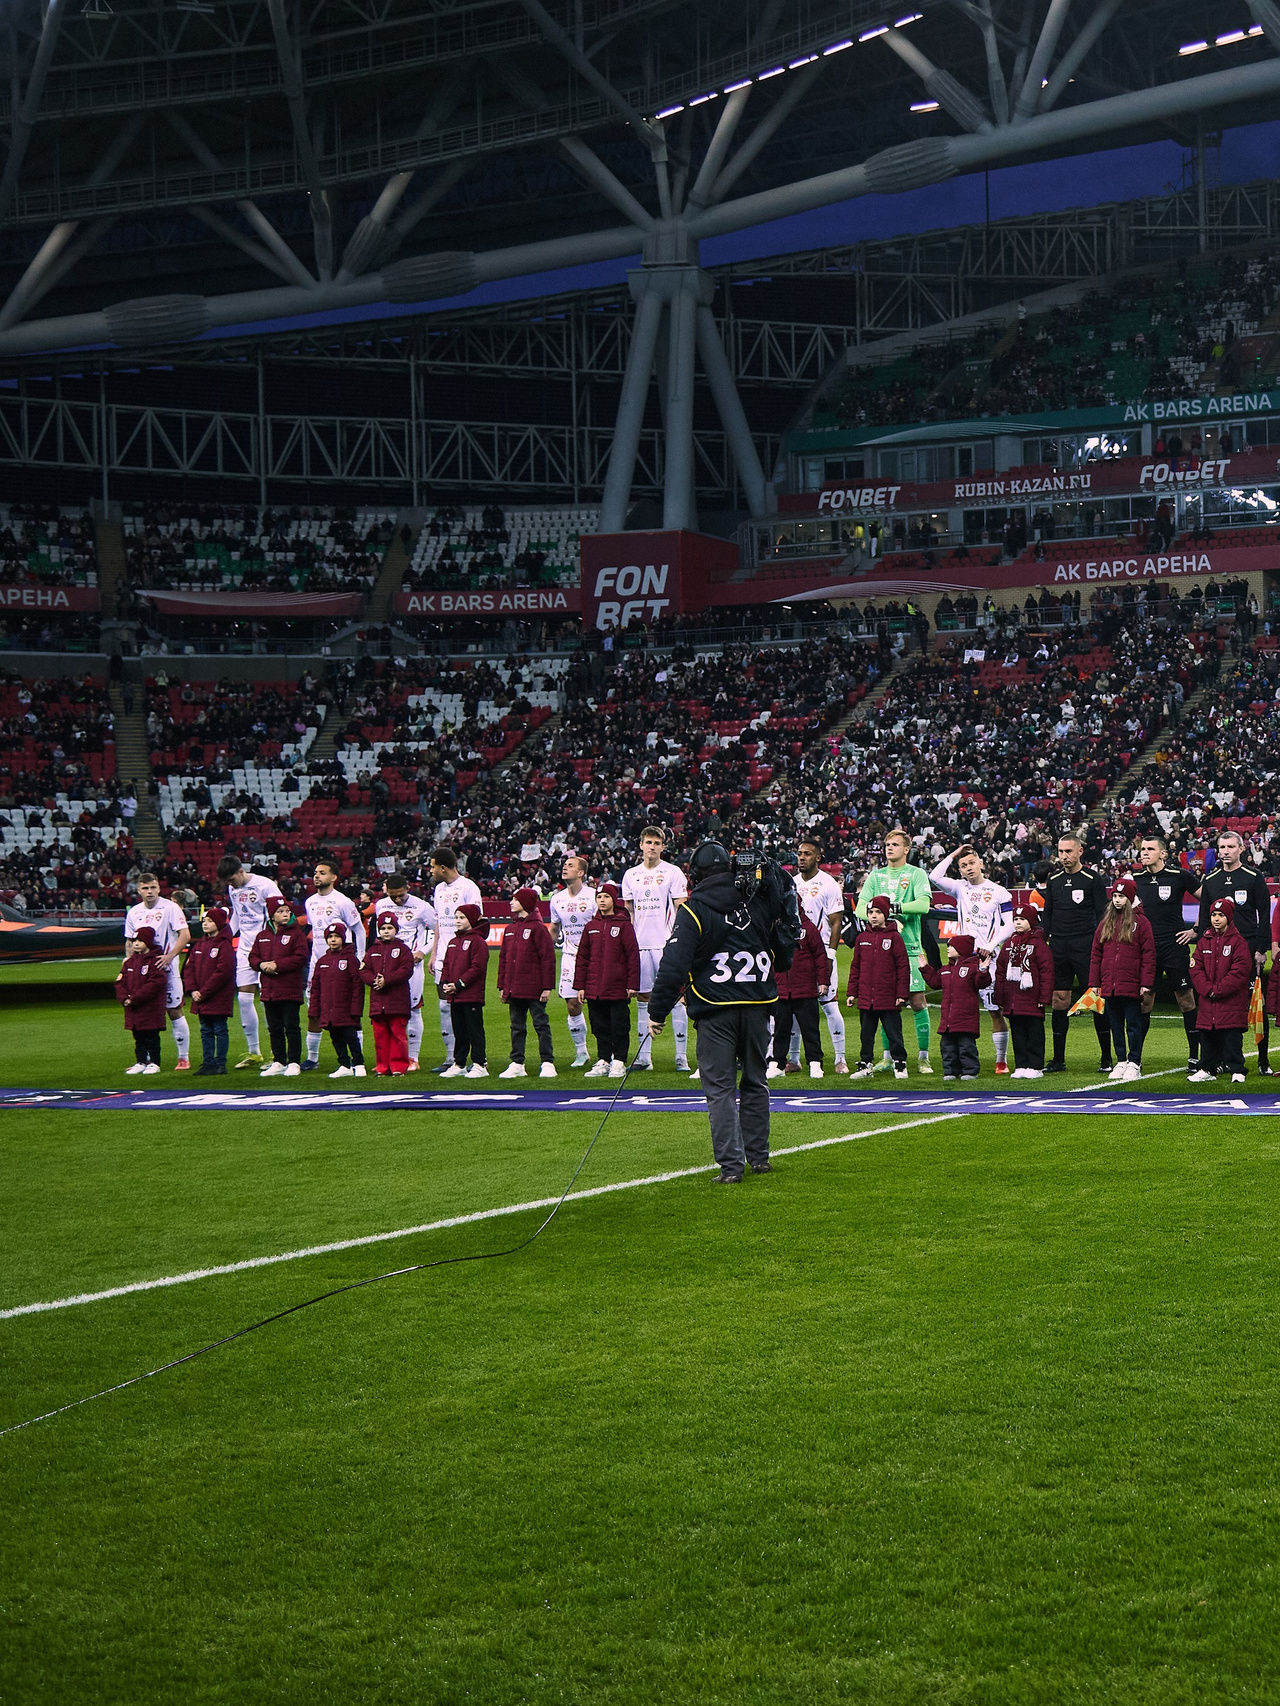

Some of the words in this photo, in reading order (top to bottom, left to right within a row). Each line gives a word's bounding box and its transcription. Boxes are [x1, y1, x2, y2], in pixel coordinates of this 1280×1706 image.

[1124, 404, 1149, 422] AK
[1153, 399, 1202, 419] BARS
[1207, 393, 1272, 415] ARENA
[817, 486, 901, 509] FONBET
[954, 474, 1093, 499] RUBIN-KAZAN.RU
[594, 564, 669, 598] FON
[1054, 563, 1081, 581] АК
[1086, 559, 1138, 580] БАРС
[1143, 554, 1212, 575] АРЕНА
[407, 596, 436, 612] AK
[440, 594, 495, 612] BARS
[499, 592, 568, 610] ARENA
[709, 950, 772, 984] 329
